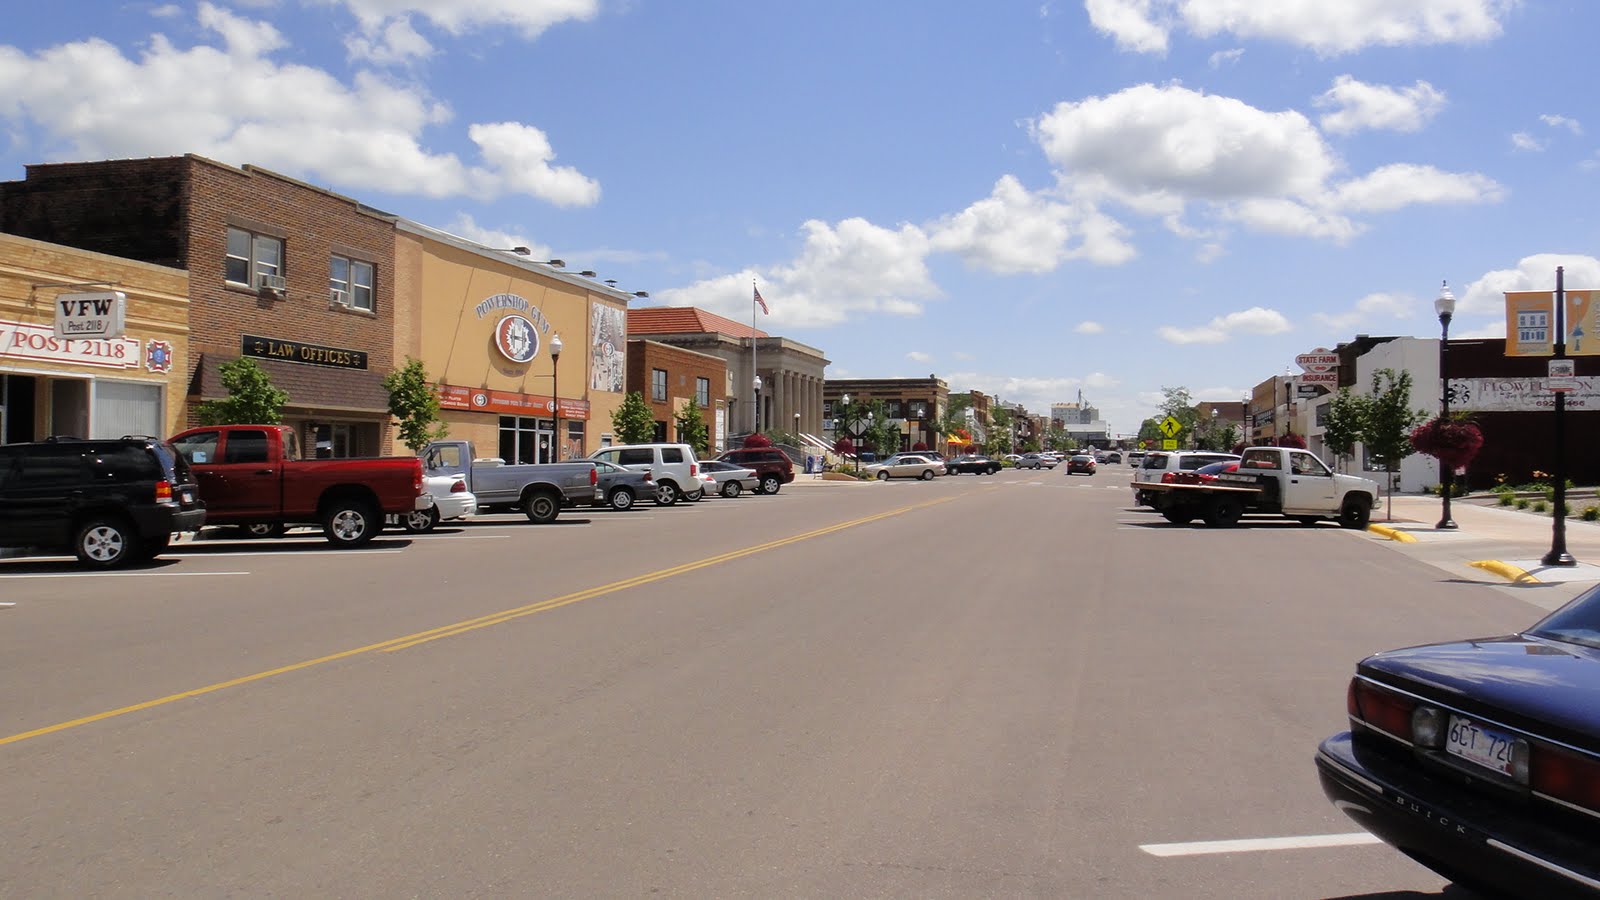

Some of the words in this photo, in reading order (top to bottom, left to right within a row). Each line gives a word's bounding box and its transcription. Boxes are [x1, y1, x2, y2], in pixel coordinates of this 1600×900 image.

[60, 299, 113, 316] VFW
[475, 293, 529, 319] POWERSHOP
[531, 305, 550, 335] GYM
[68, 321, 84, 331] Post
[86, 320, 102, 331] 2118
[12, 331, 74, 353] POST
[82, 340, 125, 358] 2118
[268, 341, 295, 357] LAW
[301, 346, 350, 365] OFFICES
[1450, 723, 1478, 749] 6CT
[1396, 796, 1465, 833] BUICK
